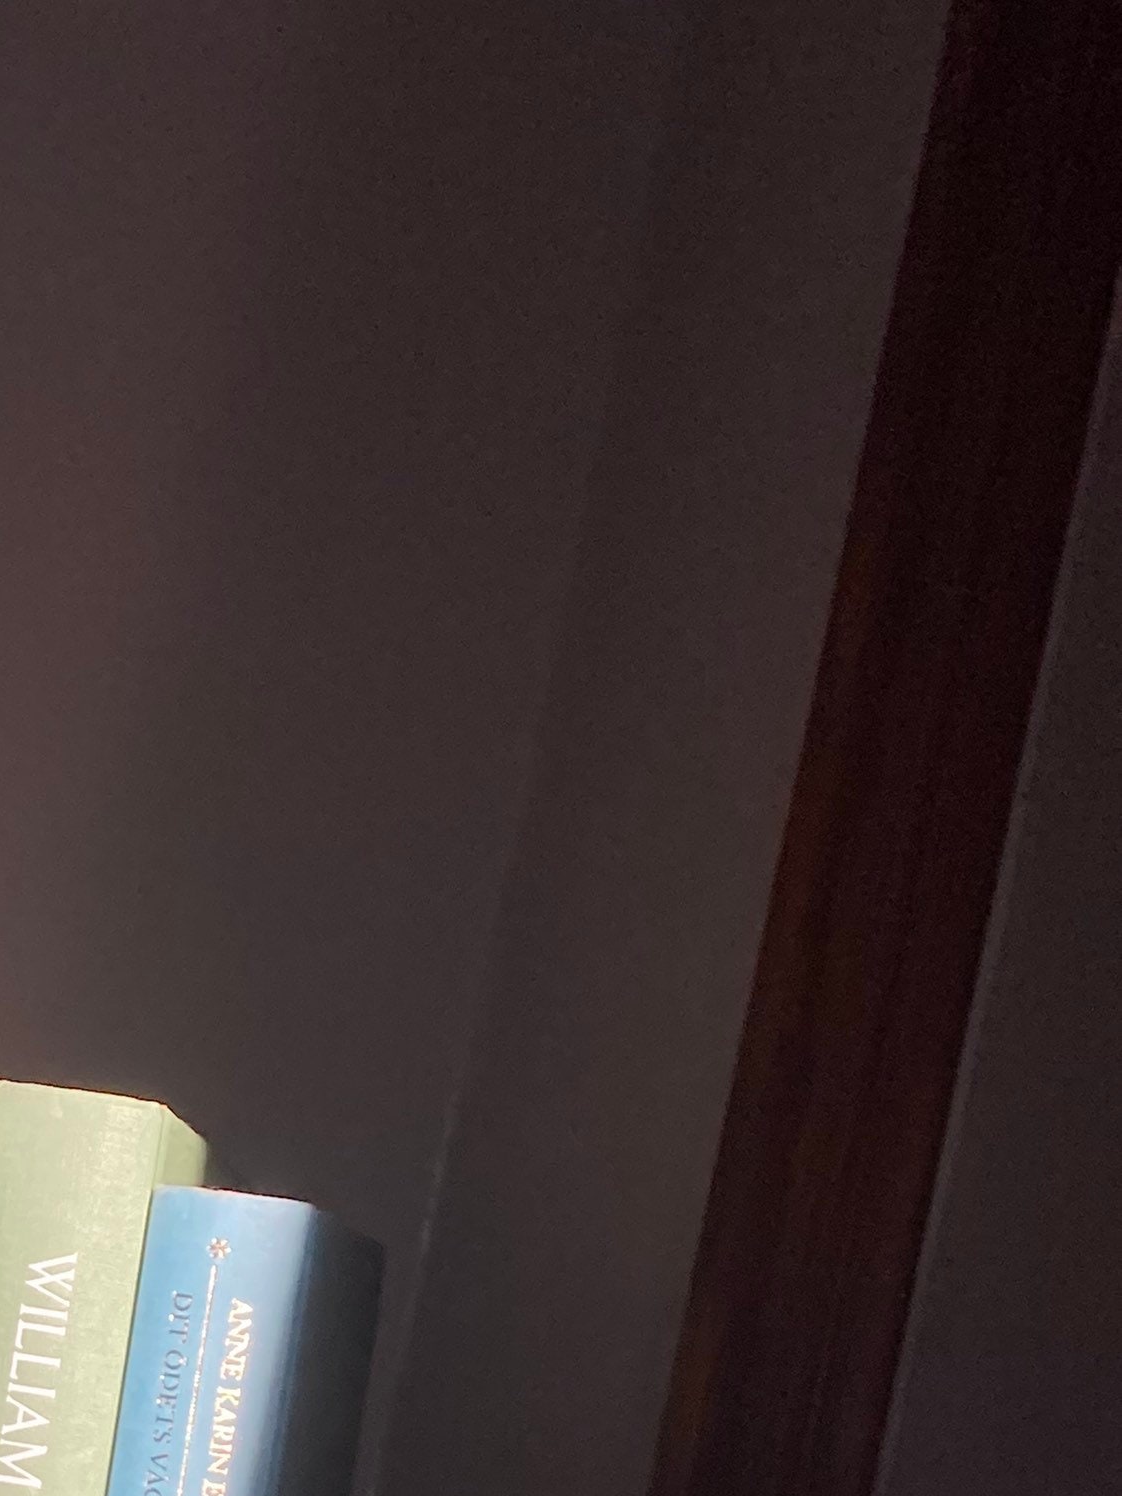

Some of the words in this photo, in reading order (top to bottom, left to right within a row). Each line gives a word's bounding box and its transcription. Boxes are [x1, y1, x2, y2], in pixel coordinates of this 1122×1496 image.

[167, 1290, 192, 1344] DIT
[218, 1296, 253, 1381] ANNE
[151, 1349, 188, 1444] ÖDETS
[204, 1386, 242, 1475] KARIN
